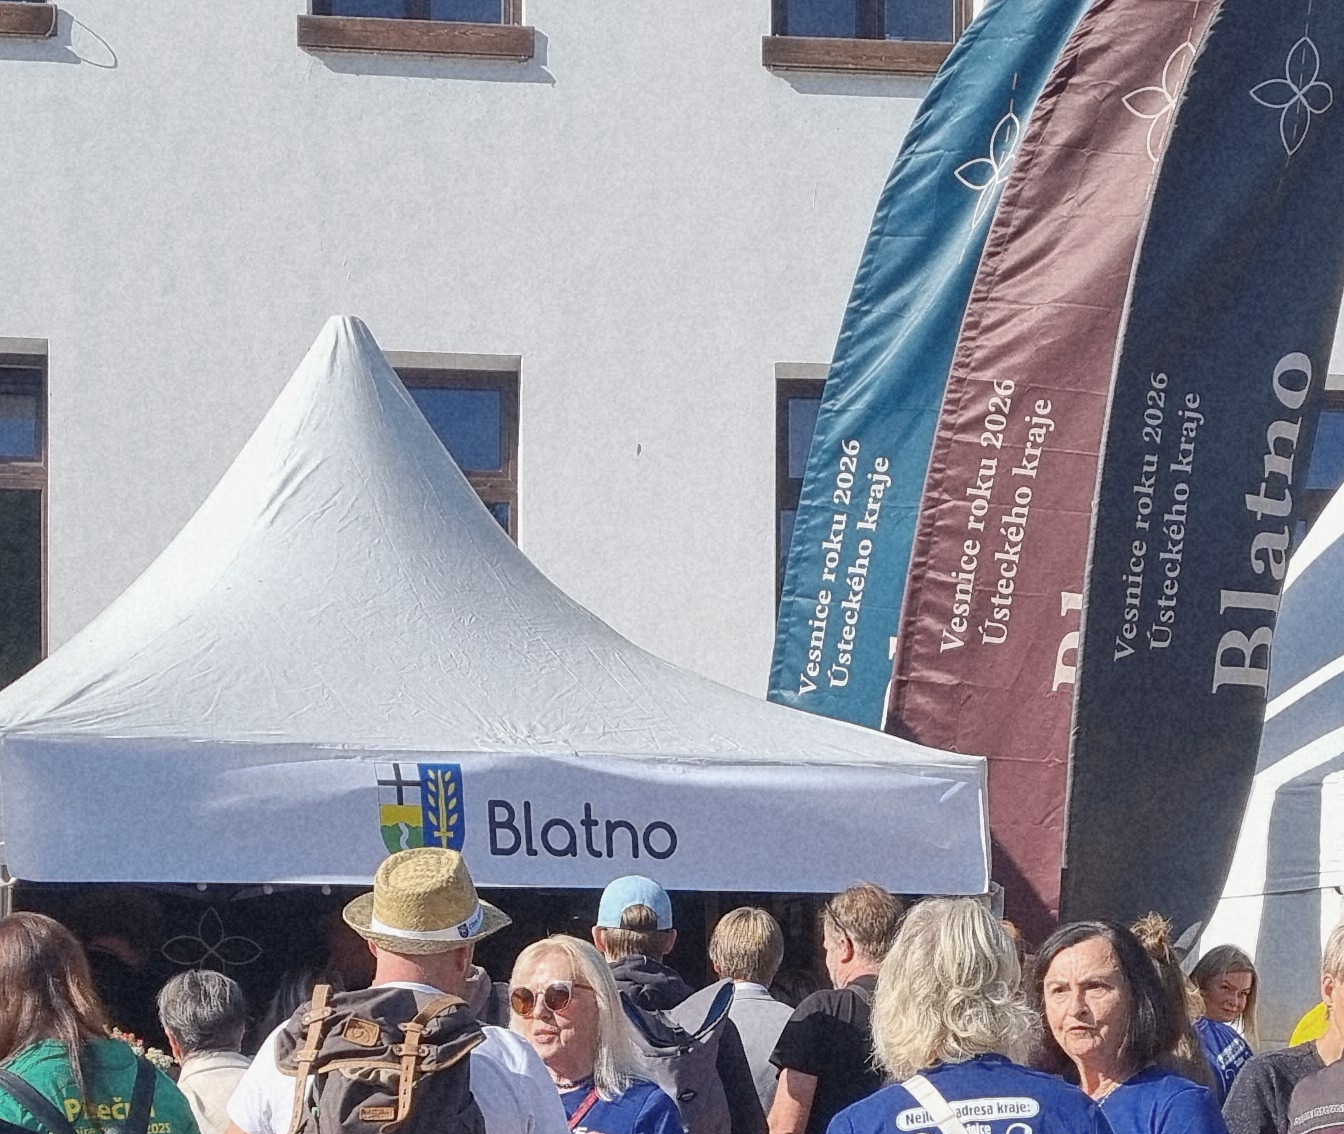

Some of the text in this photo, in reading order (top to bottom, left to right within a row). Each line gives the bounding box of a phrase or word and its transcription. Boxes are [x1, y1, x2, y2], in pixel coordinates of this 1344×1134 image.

[798, 439, 860, 696] Vesnice roku 2026
[827, 456, 892, 687] Ústeckého kraje
[940, 379, 1015, 653] Vesnice roku 2026
[978, 399, 1055, 645] Ústeckého kraje
[1114, 372, 1169, 662] Vesnice roku 2026
[1146, 393, 1205, 651] Ústeckého kraje
[1211, 352, 1312, 698] Blatno
[487, 800, 678, 860] Blatno
[956, 1102, 994, 1118] adresa
[997, 1101, 1031, 1114] kraje:
